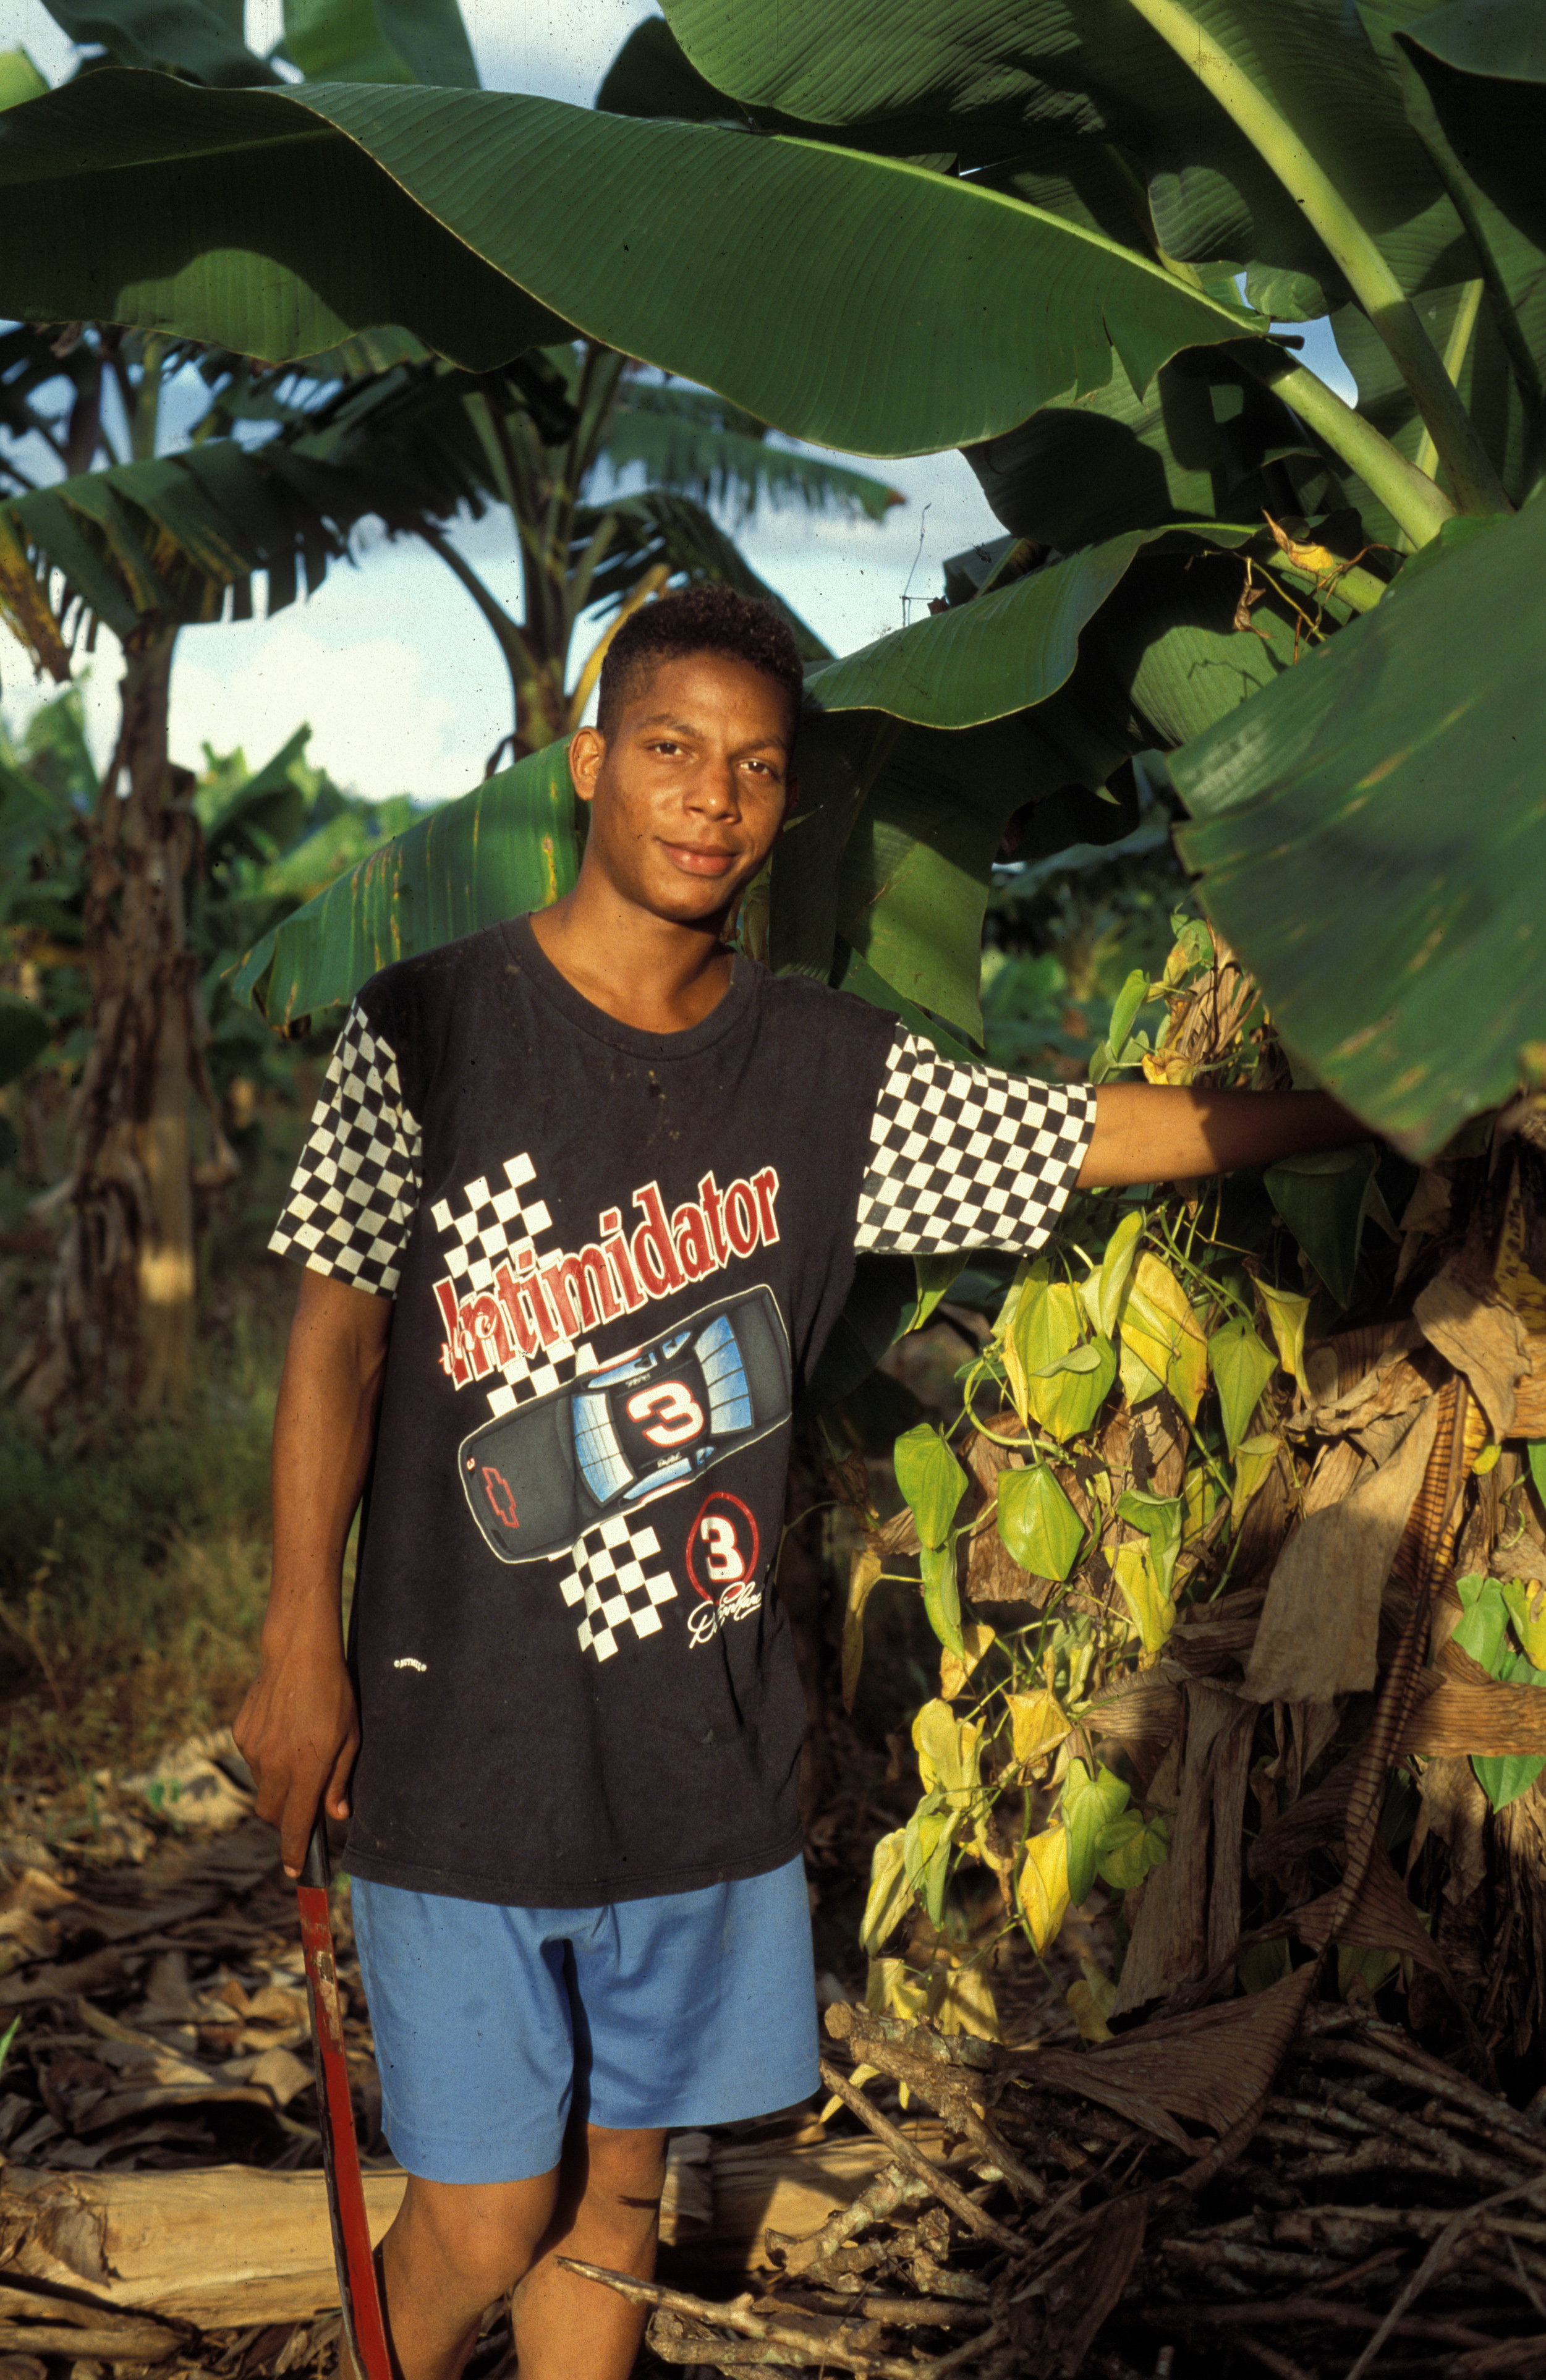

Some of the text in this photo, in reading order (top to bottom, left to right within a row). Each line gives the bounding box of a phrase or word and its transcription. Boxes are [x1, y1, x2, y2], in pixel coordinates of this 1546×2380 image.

[433, 1166, 780, 1391] Intimidator
[438, 1312, 497, 1375] the
[626, 1380, 704, 1447] 3
[700, 1515, 745, 1583] 3
